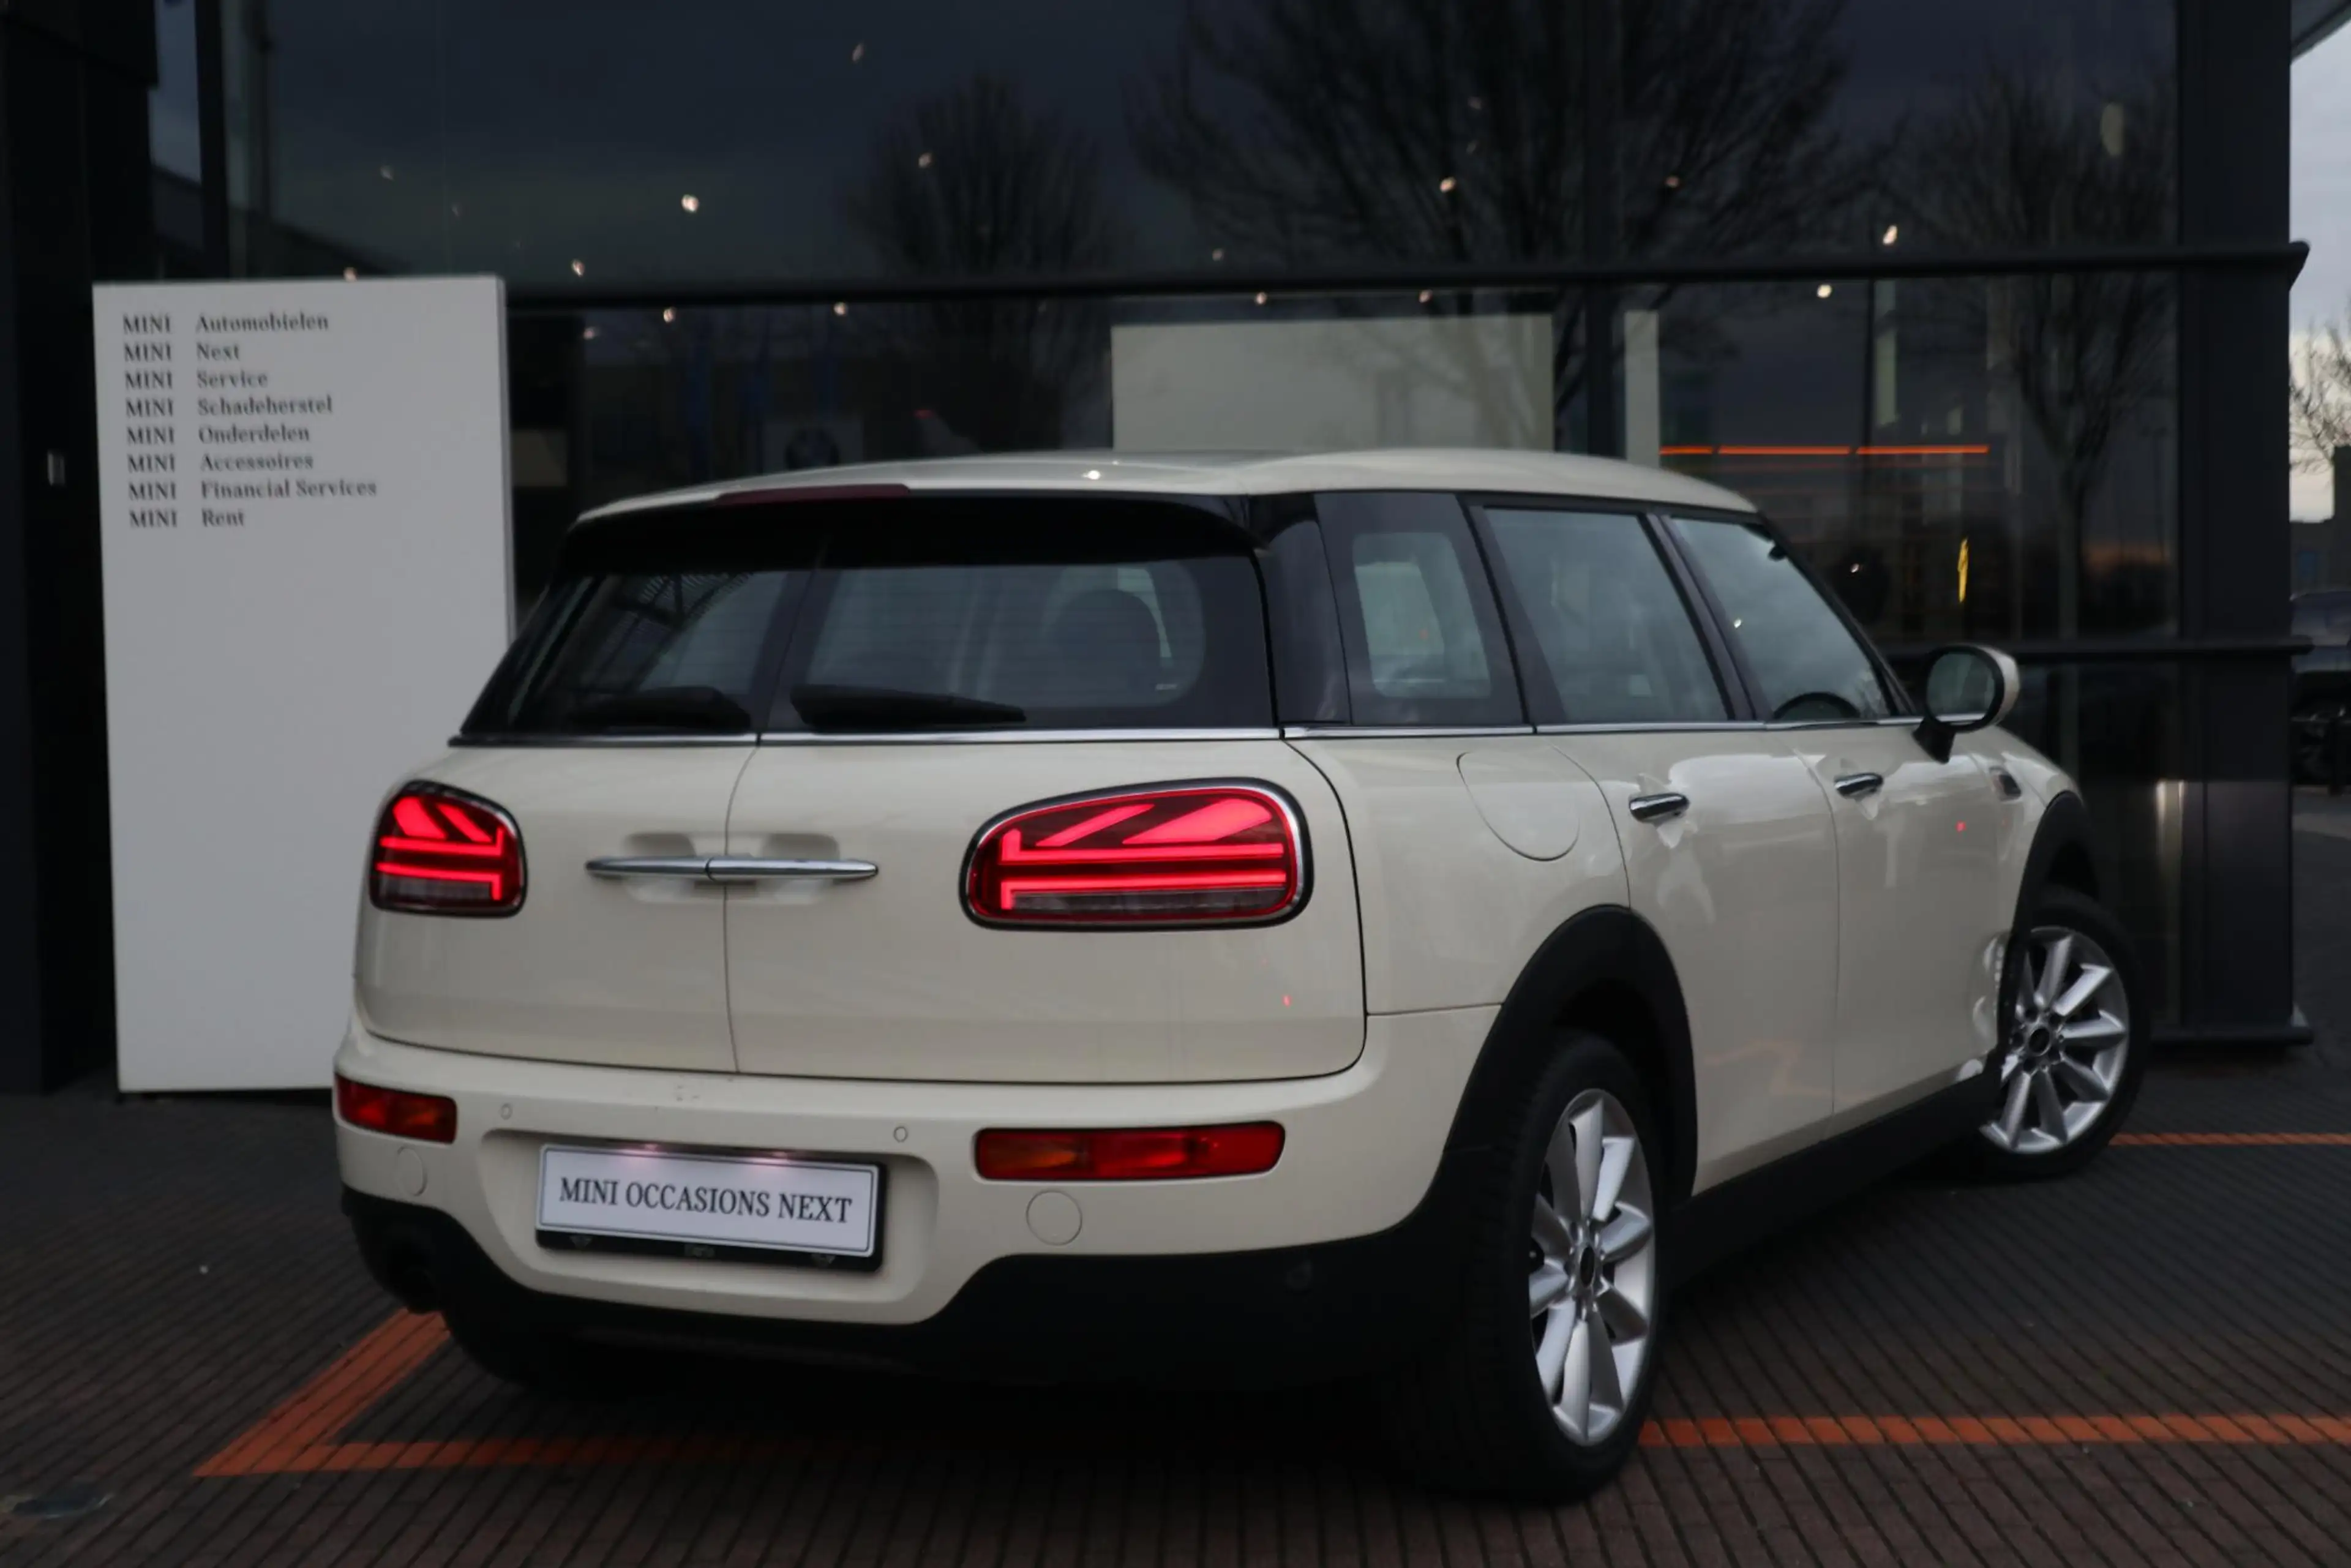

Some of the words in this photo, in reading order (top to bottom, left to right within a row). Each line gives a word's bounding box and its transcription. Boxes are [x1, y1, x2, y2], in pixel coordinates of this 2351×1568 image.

[123, 313, 170, 334] MINI
[196, 311, 328, 333] Automobielen
[124, 342, 171, 362] MINI
[197, 342, 239, 361] Next
[125, 370, 172, 389] MINI
[197, 370, 268, 388] Service
[126, 398, 173, 418] MINI
[198, 394, 332, 416] Schadeherstel
[127, 426, 174, 445] MINI
[198, 423, 309, 444] Onderdelen
[127, 453, 175, 473] MINI
[200, 452, 313, 471] Accessoires
[129, 481, 176, 500] MINI
[201, 479, 290, 499] Financial
[296, 479, 377, 497] Services
[129, 509, 177, 528] MINI
[201, 508, 244, 527] Rent
[560, 1177, 618, 1205] MINI
[626, 1182, 770, 1217] OCCASIONS
[778, 1193, 852, 1223] NEXT
